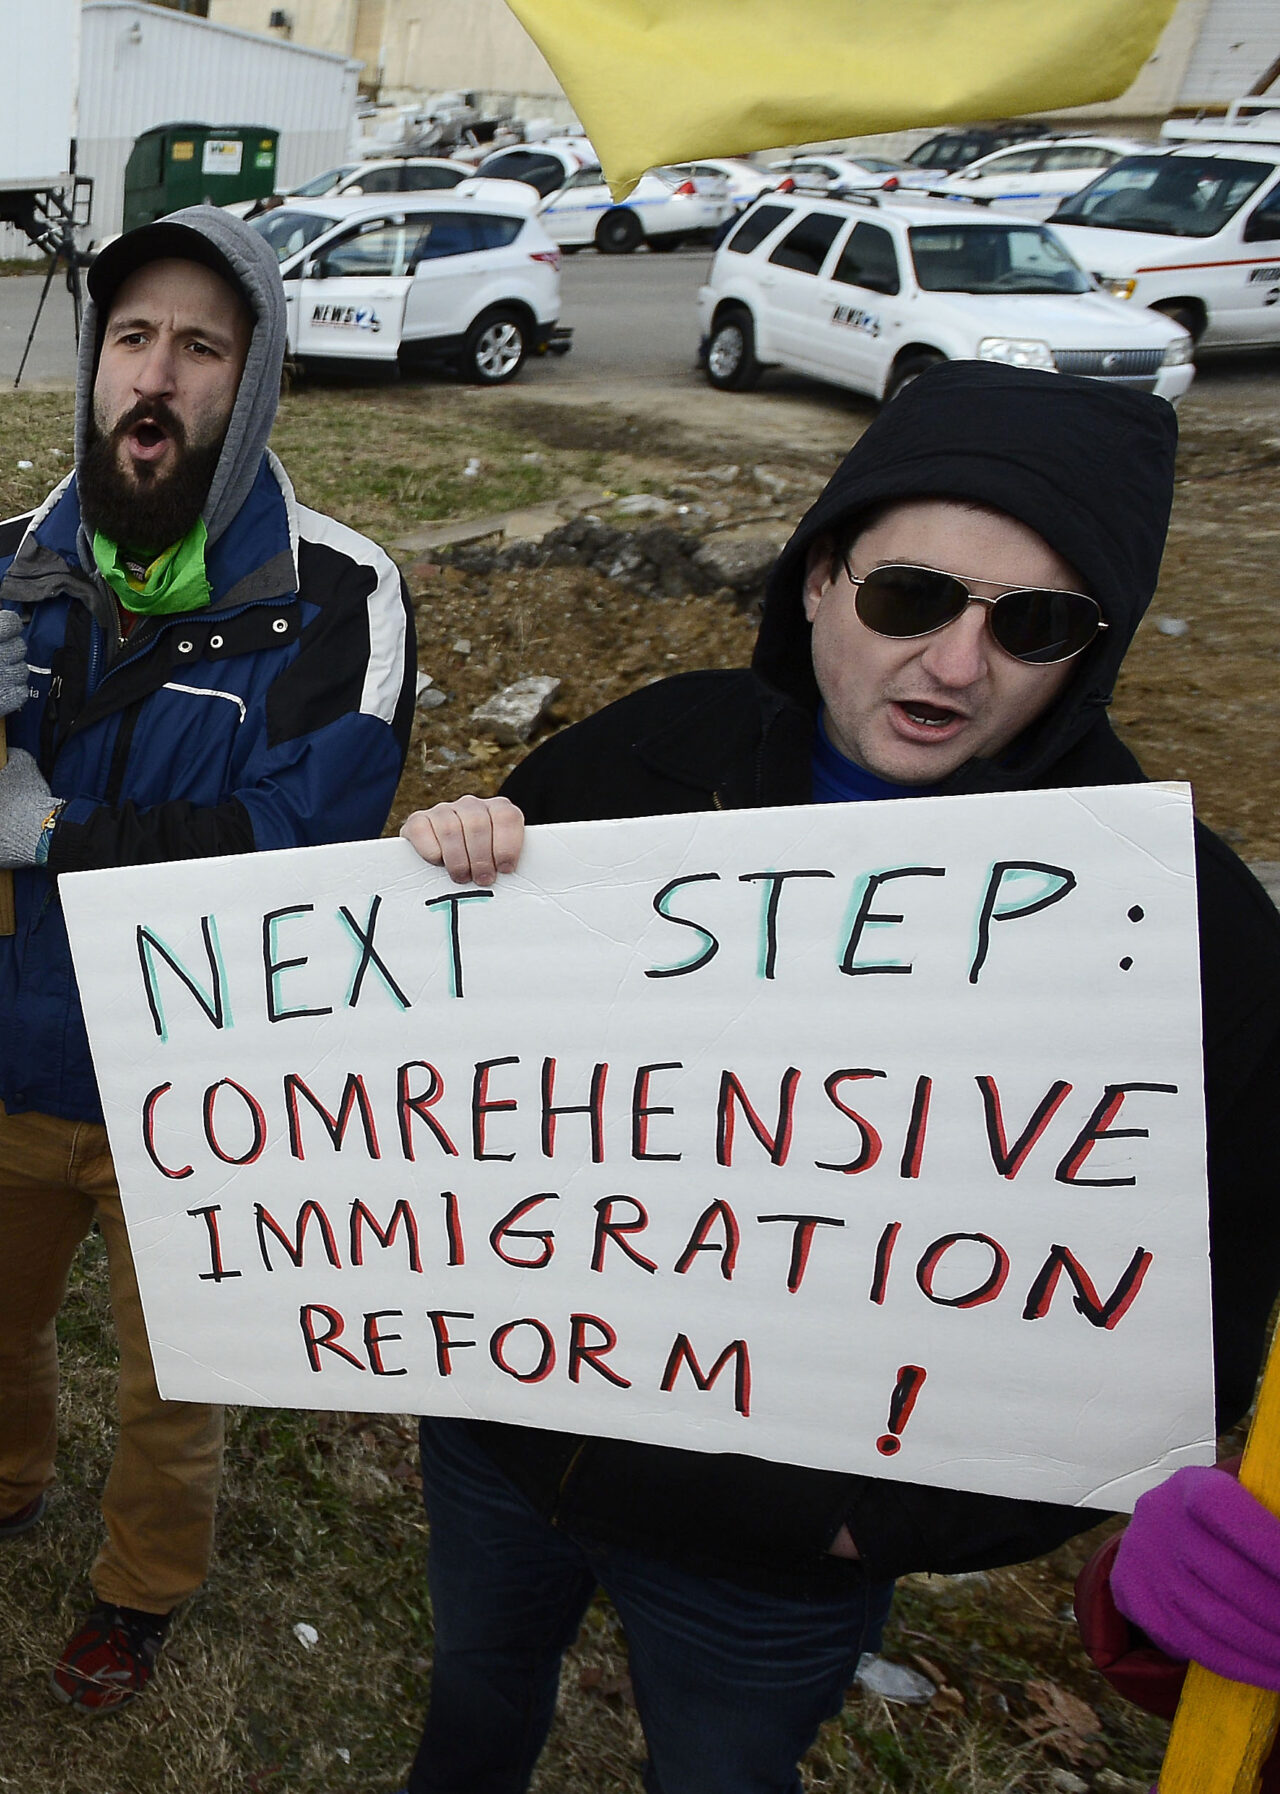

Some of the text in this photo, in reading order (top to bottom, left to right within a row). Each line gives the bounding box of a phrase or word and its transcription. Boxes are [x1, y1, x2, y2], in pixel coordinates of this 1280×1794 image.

[136, 889, 494, 1044] NEXT
[142, 1055, 1179, 1187] COMREHENSIVE
[186, 1191, 1154, 1331] IMMIGRATION
